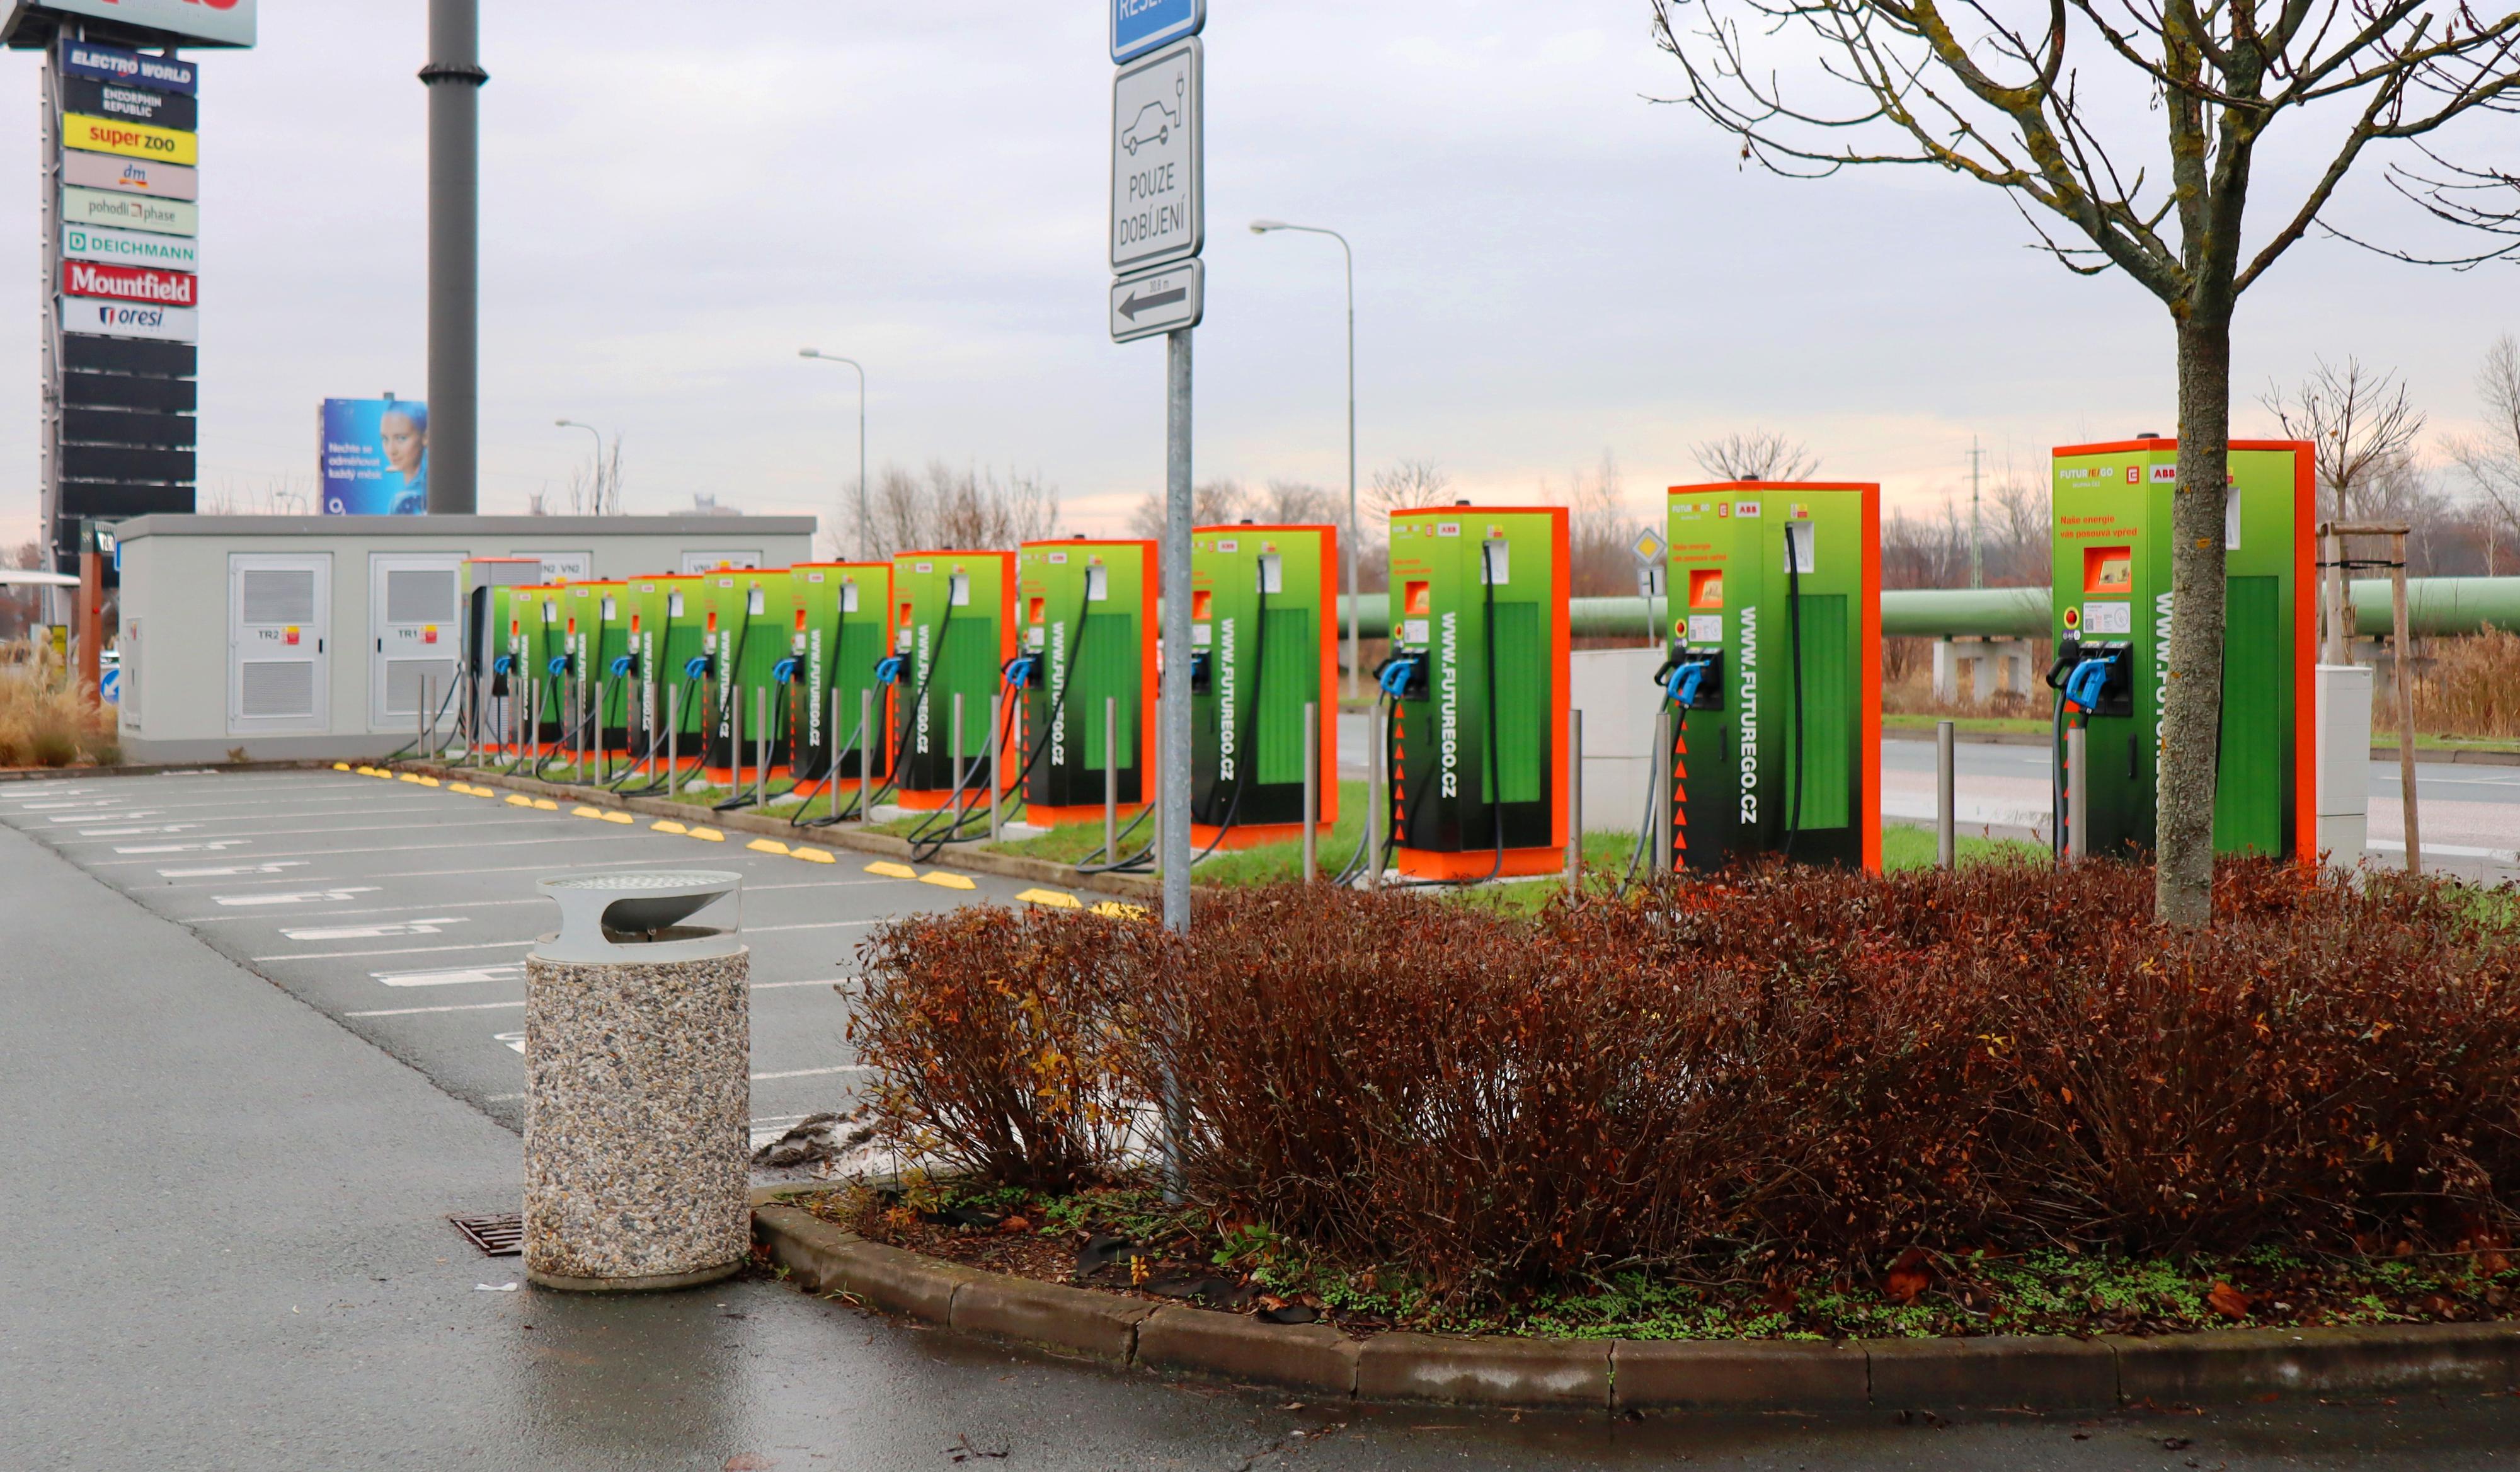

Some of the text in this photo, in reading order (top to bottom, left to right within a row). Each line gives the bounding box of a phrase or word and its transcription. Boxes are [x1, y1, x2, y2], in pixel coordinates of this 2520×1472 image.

[71, 49, 192, 84] ELECTRO WORLD
[103, 88, 162, 107] ENDORPHIN
[103, 100, 152, 118] REPUBLIC
[89, 127, 175, 152] super zoo
[123, 164, 146, 180] dm
[1129, 162, 1175, 203] POUZE
[144, 206, 175, 222] phase
[1120, 193, 1185, 246] DOBÍJENÍ
[92, 238, 194, 260] DEICHMANN
[72, 266, 192, 302] Mountfield
[119, 305, 164, 326] oresi
[2154, 469, 2175, 479] ABB
[1739, 506, 1757, 514] ABB
[2083, 514, 2116, 526] energie
[258, 630, 279, 640] TR2
[398, 630, 418, 638] TR1
[1220, 618, 1234, 781] WWW.FUTUREGO.CZ
[1441, 612, 1457, 798] WWW.FUTUREGO.CZ
[1741, 606, 1757, 824] WWW.FUTUREGO.CZ
